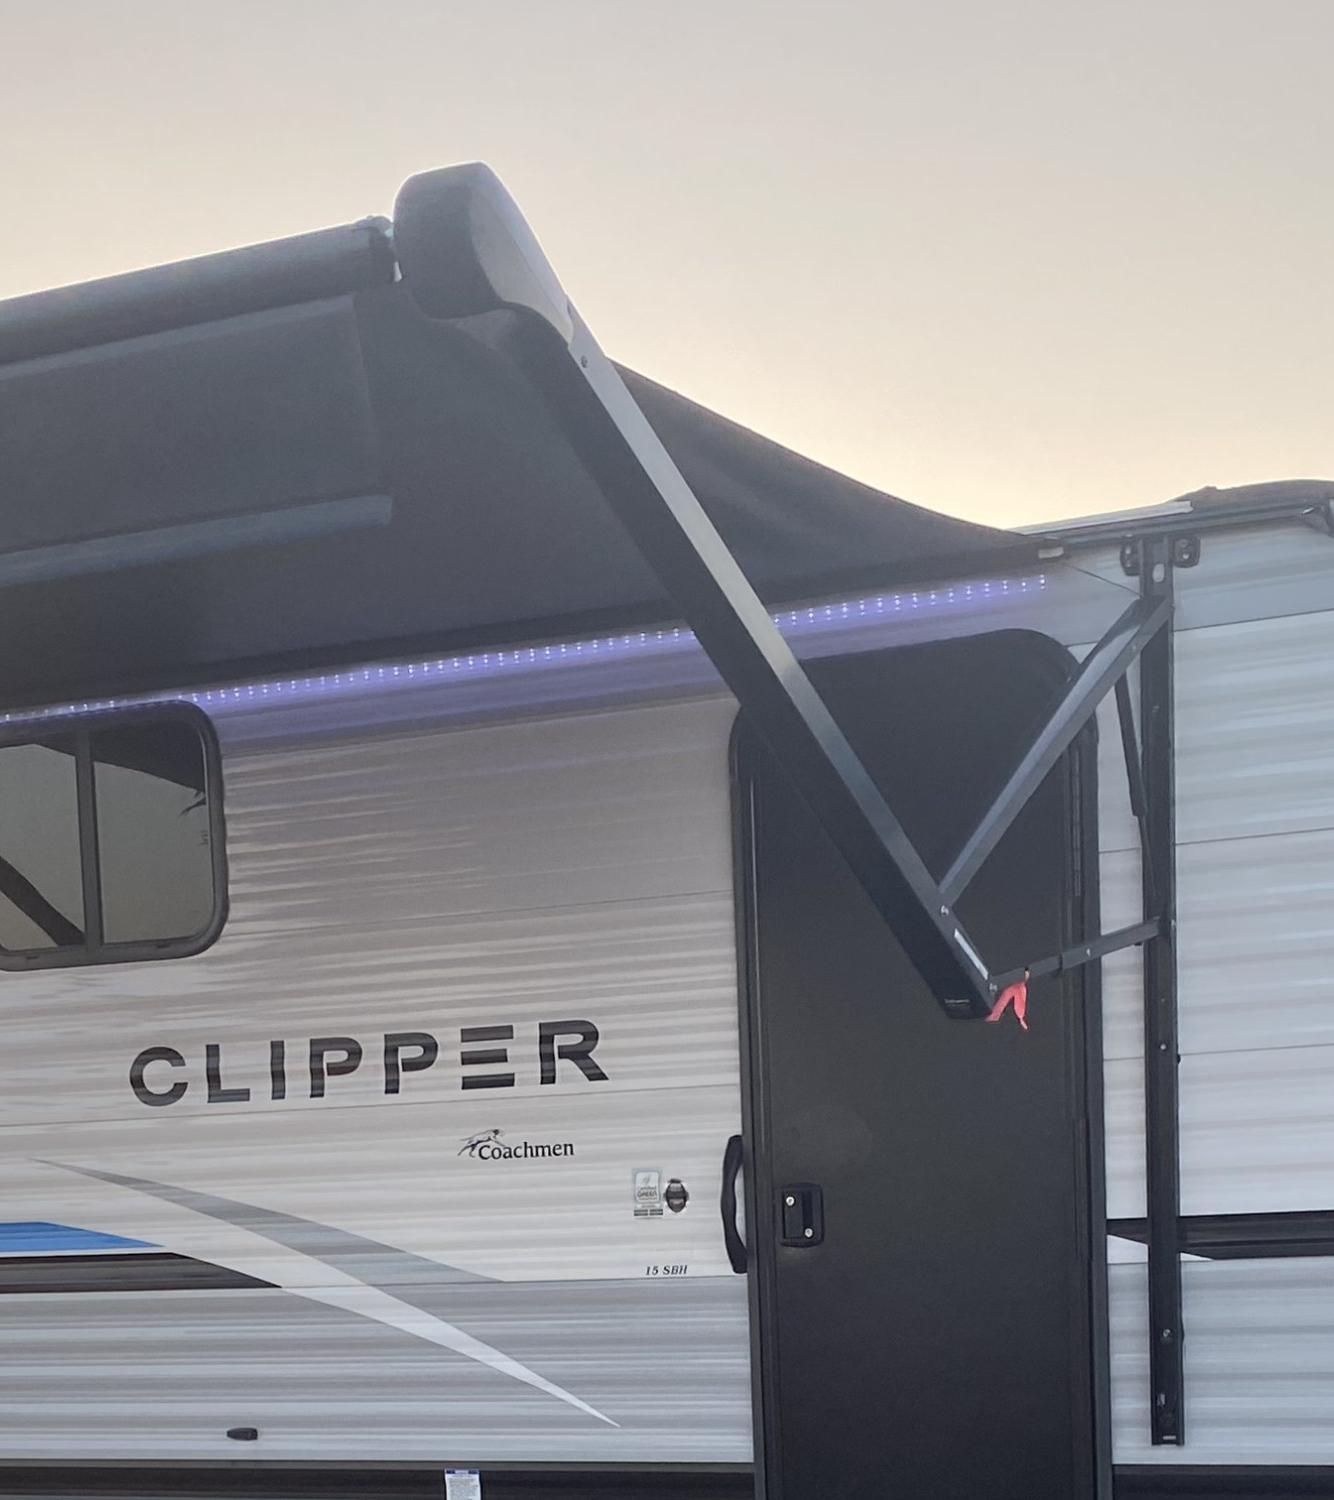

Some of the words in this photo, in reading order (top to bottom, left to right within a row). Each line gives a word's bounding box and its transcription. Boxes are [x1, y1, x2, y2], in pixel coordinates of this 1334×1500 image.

[128, 1019, 610, 1107] CLIPPER
[478, 1141, 574, 1160] Coachmen
[646, 1265, 659, 1276] 15
[662, 1264, 689, 1275] SBH
